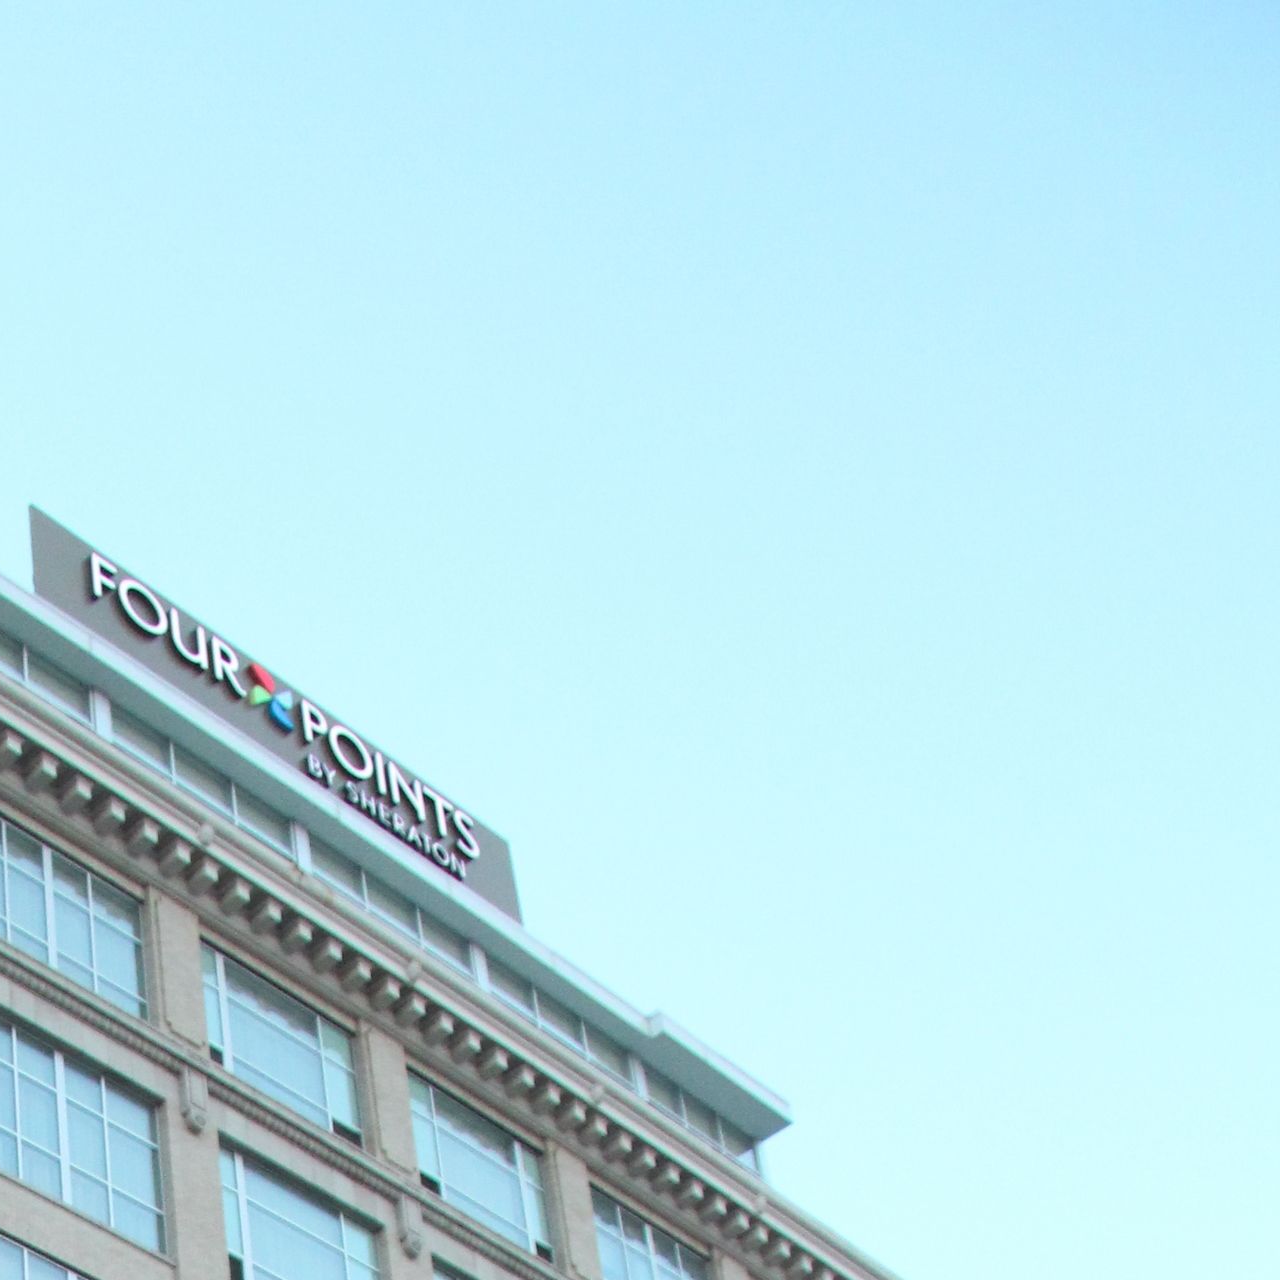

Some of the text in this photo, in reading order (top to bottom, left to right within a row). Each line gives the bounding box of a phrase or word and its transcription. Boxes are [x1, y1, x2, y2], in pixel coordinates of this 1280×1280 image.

[90, 551, 481, 860] FOUR POINTS
[306, 753, 467, 879] BY SHERATON
